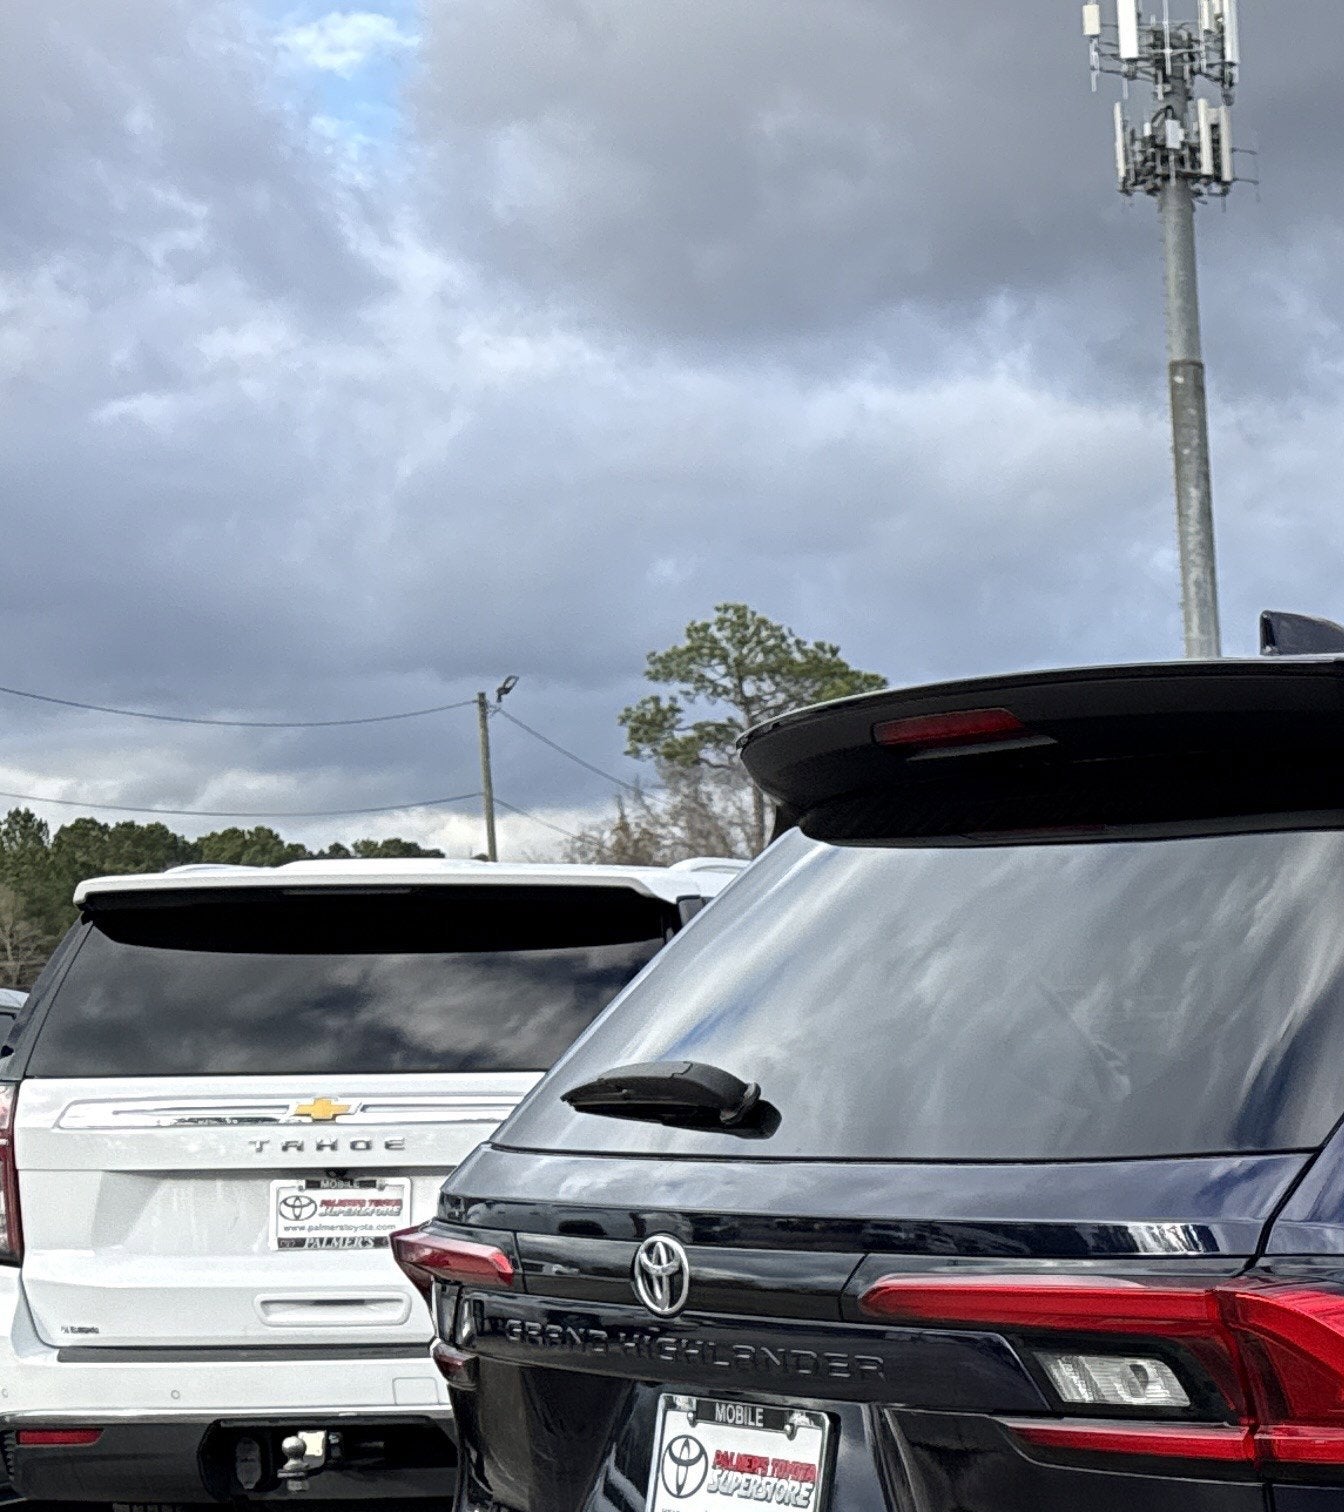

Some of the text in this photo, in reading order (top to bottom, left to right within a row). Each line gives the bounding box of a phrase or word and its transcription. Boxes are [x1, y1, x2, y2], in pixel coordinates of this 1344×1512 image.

[249, 1137, 406, 1152] TAHOE
[504, 1319, 887, 1382] GRAND HIGHLANDER
[714, 1403, 763, 1427] MOBILE
[707, 1469, 815, 1508] SUPERSTORE
